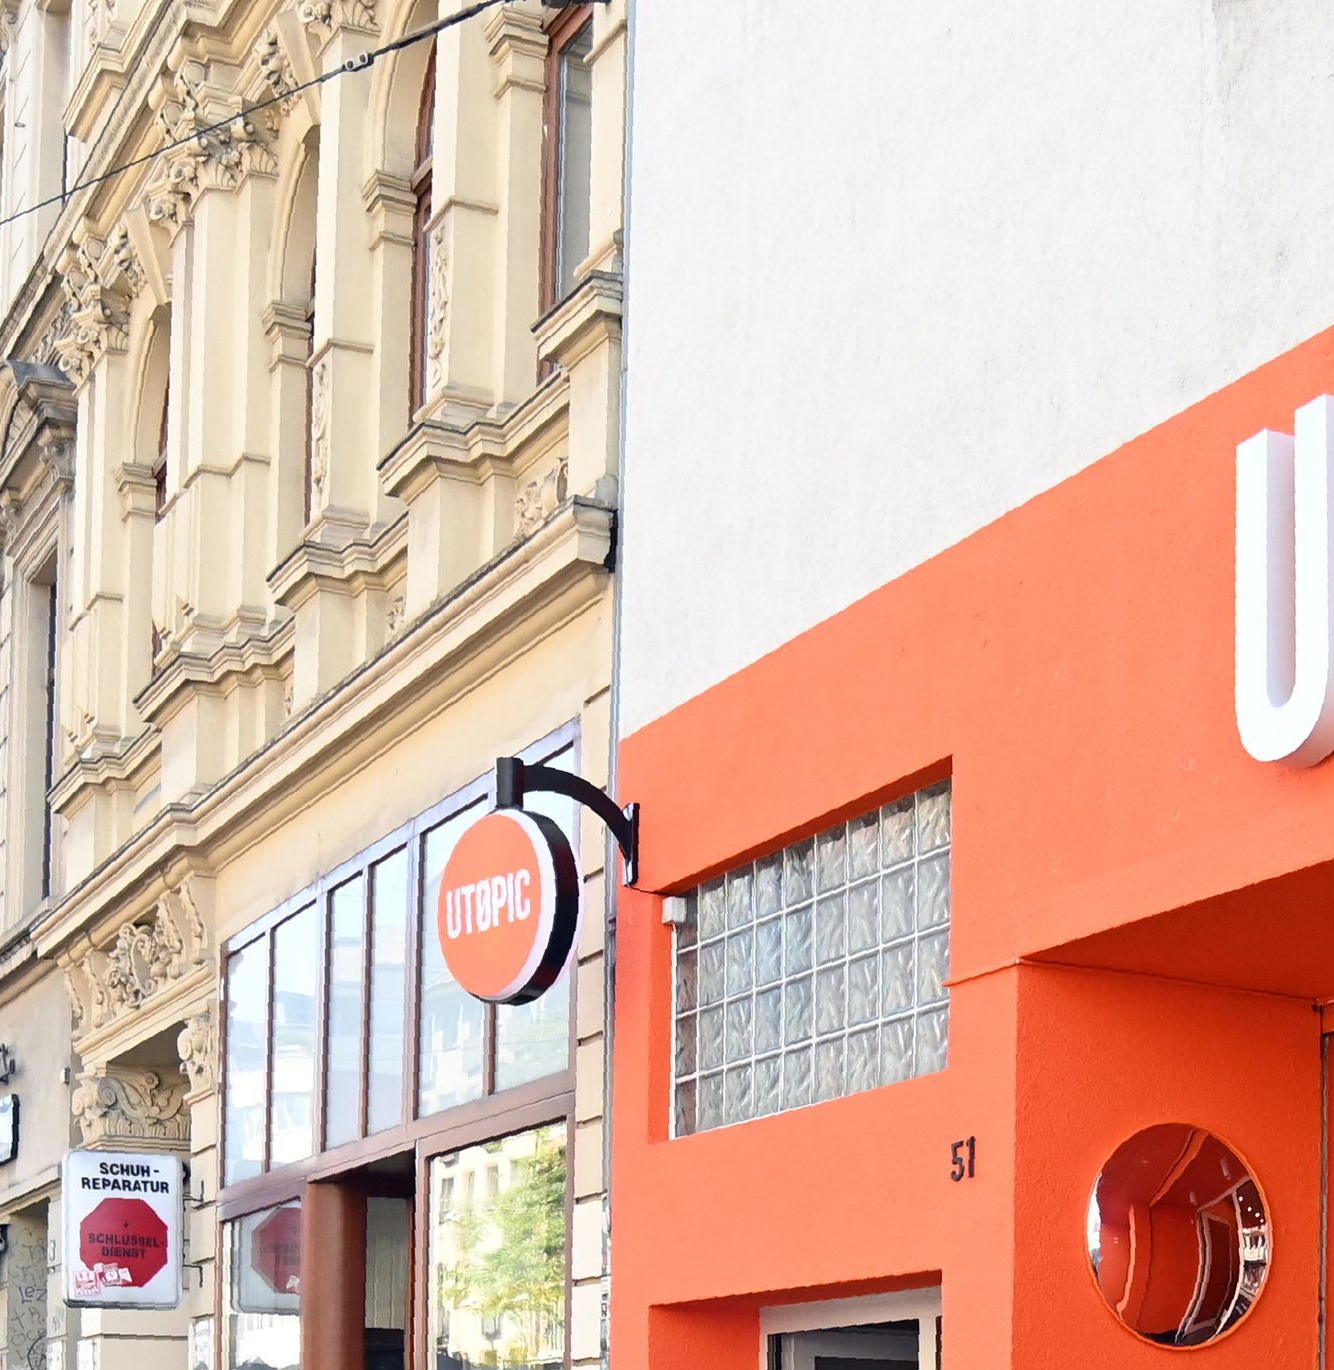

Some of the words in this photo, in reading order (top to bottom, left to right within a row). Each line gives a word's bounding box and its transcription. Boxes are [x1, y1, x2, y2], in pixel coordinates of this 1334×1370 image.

[446, 868, 531, 940] UTØPIC
[950, 1136, 976, 1182] 51
[81, 1177, 170, 1194] REPARATUR
[101, 1247, 146, 1259] DIENST
